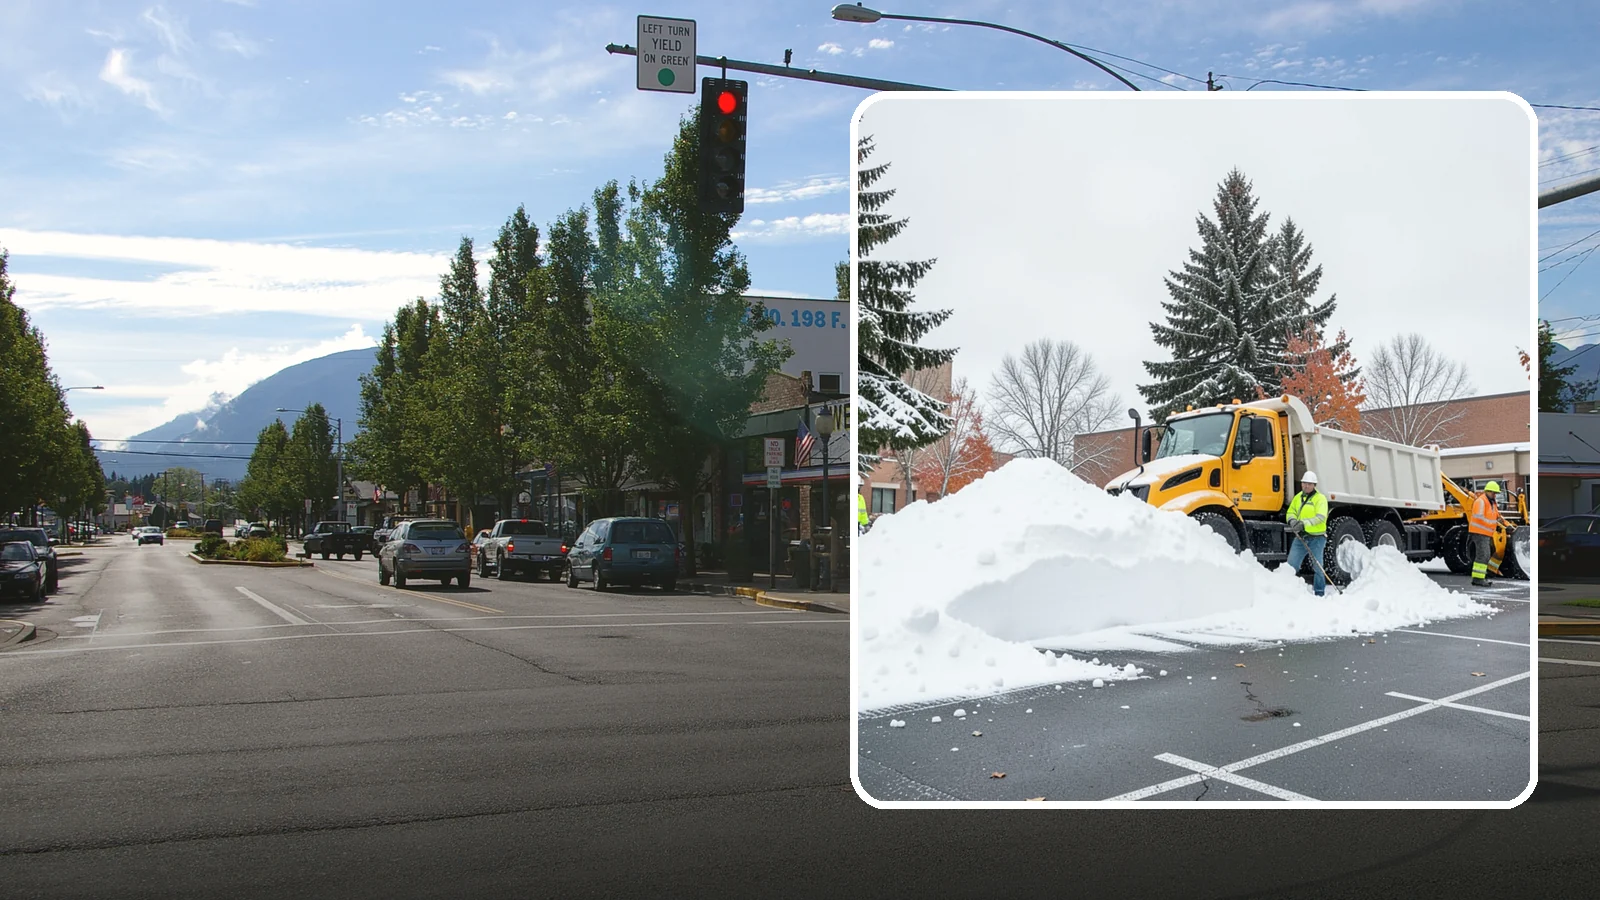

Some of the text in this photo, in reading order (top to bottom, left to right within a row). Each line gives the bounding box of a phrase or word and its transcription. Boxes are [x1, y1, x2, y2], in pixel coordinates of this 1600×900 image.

[643, 24, 690, 37] LEFT TURN
[652, 38, 682, 52] YIELD
[644, 54, 689, 66] ON GREEN
[791, 309, 826, 328] 198
[831, 311, 847, 329] F.
